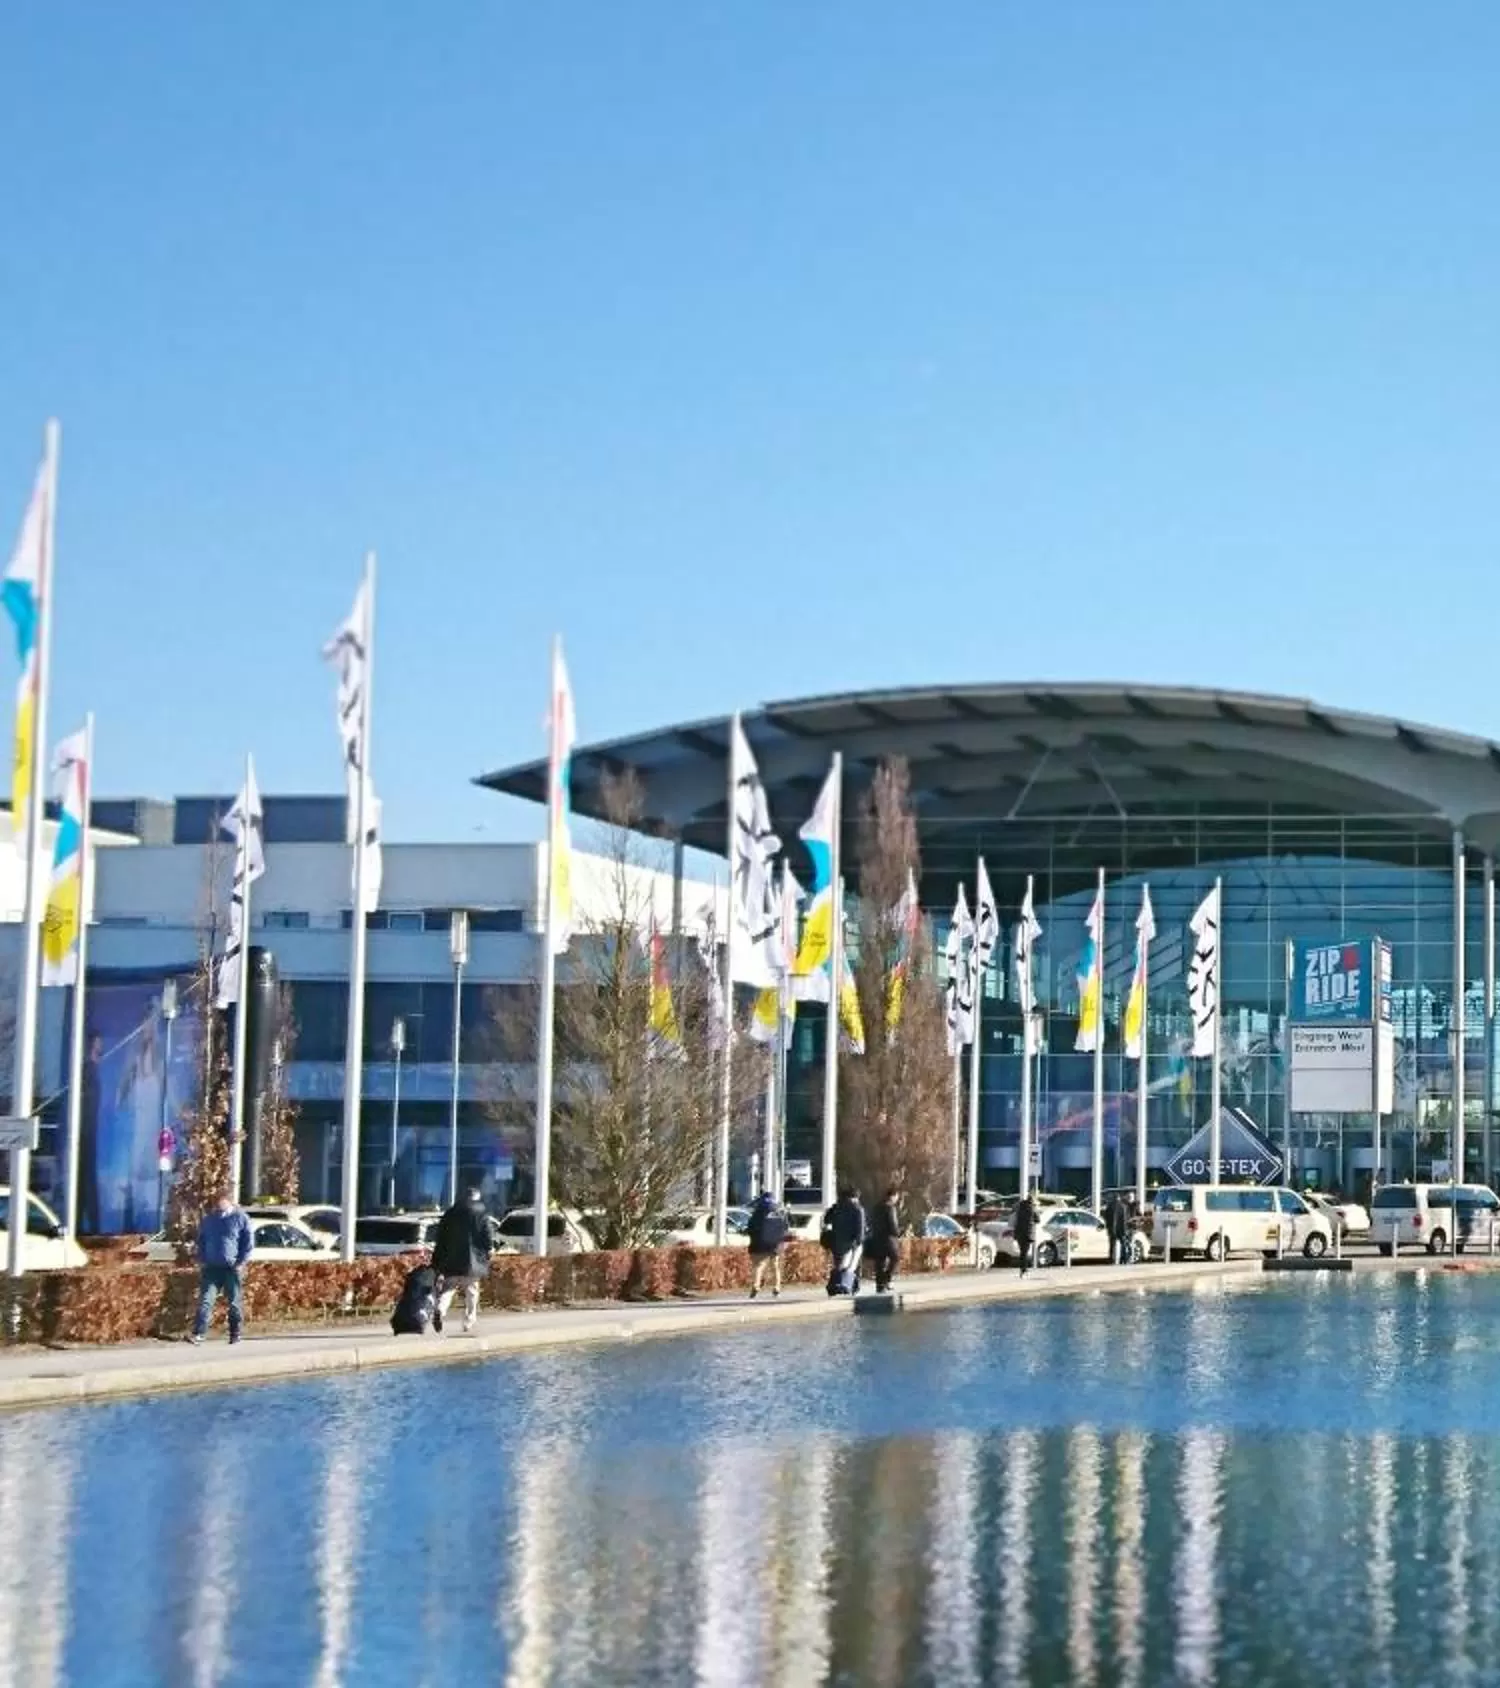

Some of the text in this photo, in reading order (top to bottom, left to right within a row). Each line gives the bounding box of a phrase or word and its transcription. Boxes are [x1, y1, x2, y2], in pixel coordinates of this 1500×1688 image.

[1306, 949, 1341, 976] ZIP
[1306, 970, 1360, 1004] RIDE
[1182, 1160, 1261, 1175] GOE-TEX
